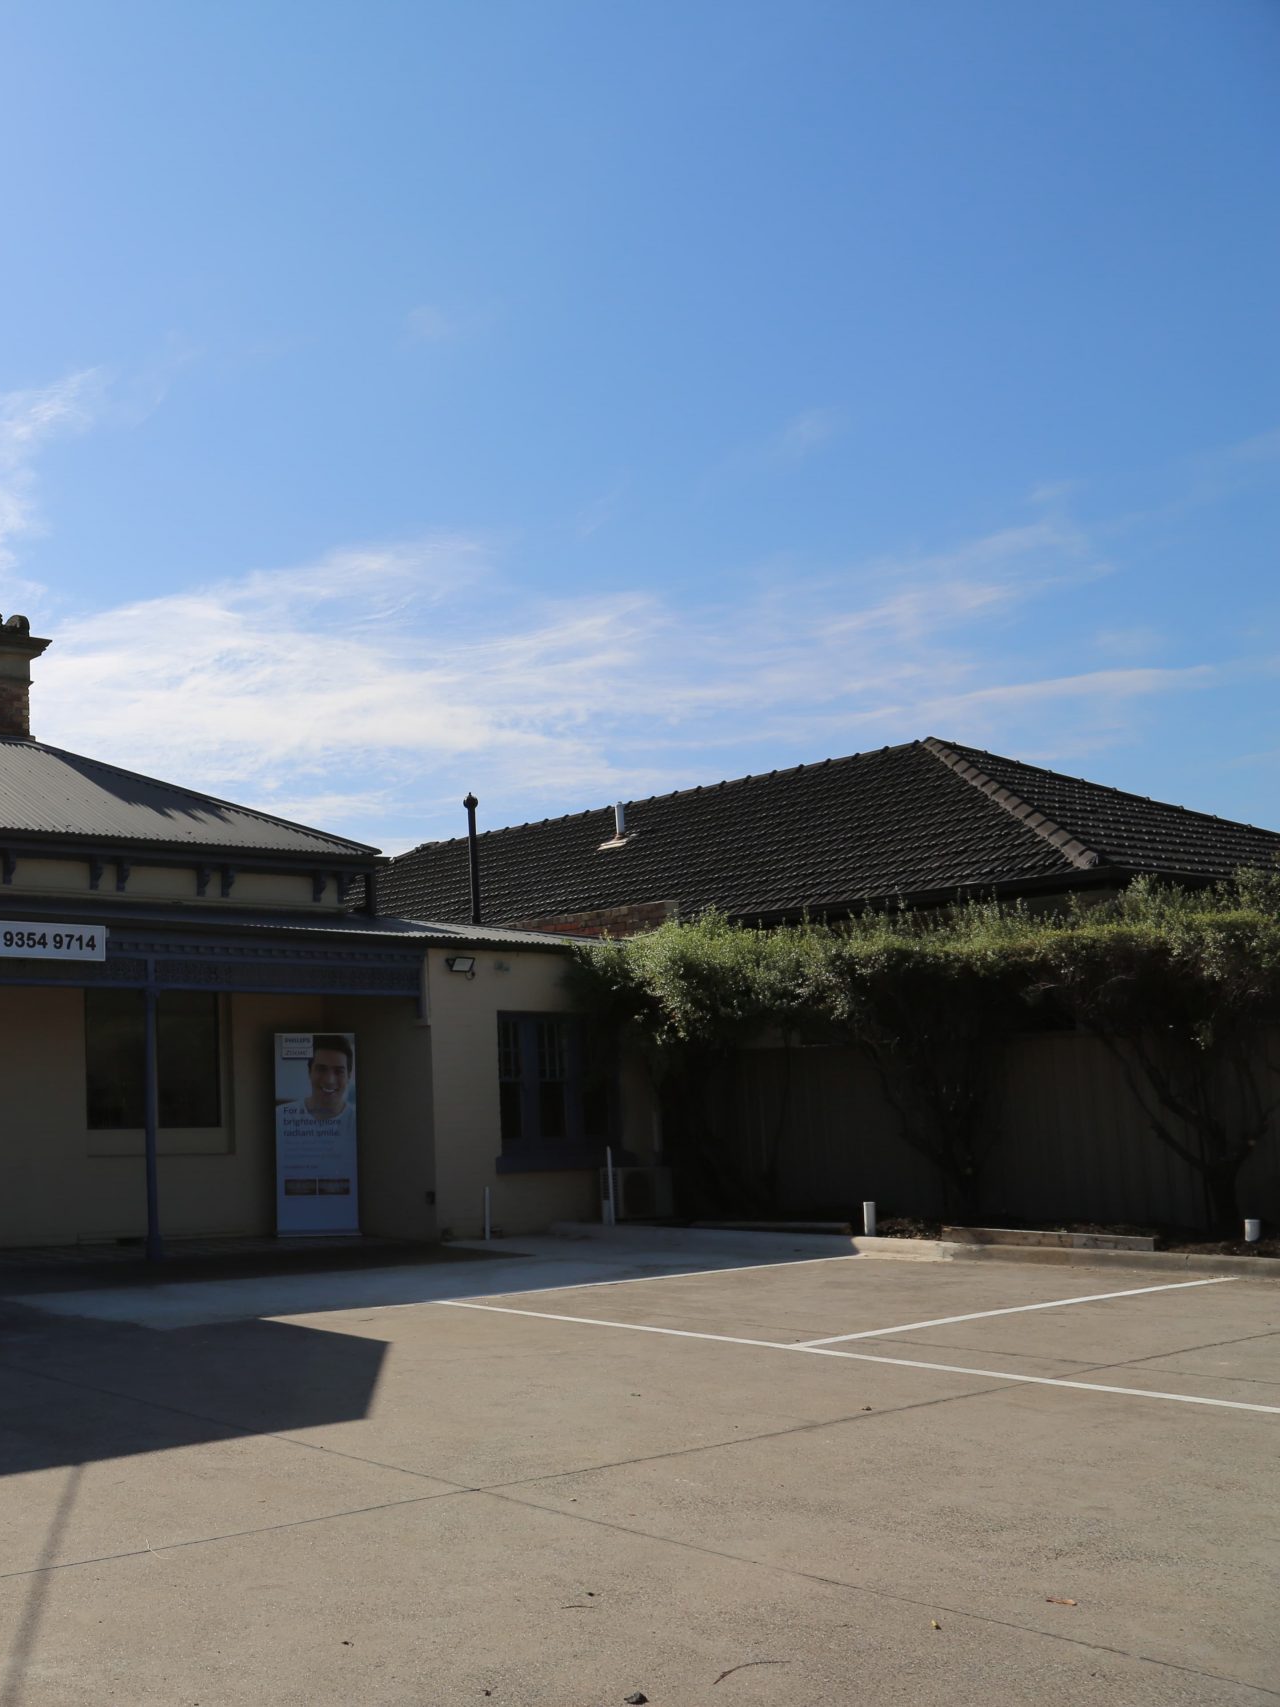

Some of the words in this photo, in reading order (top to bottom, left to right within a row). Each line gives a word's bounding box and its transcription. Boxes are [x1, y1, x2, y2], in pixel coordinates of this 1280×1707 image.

[3, 931, 48, 949] 9354
[53, 933, 97, 951] 9714
[283, 1106, 297, 1114] For
[283, 1128, 314, 1136] radiant
